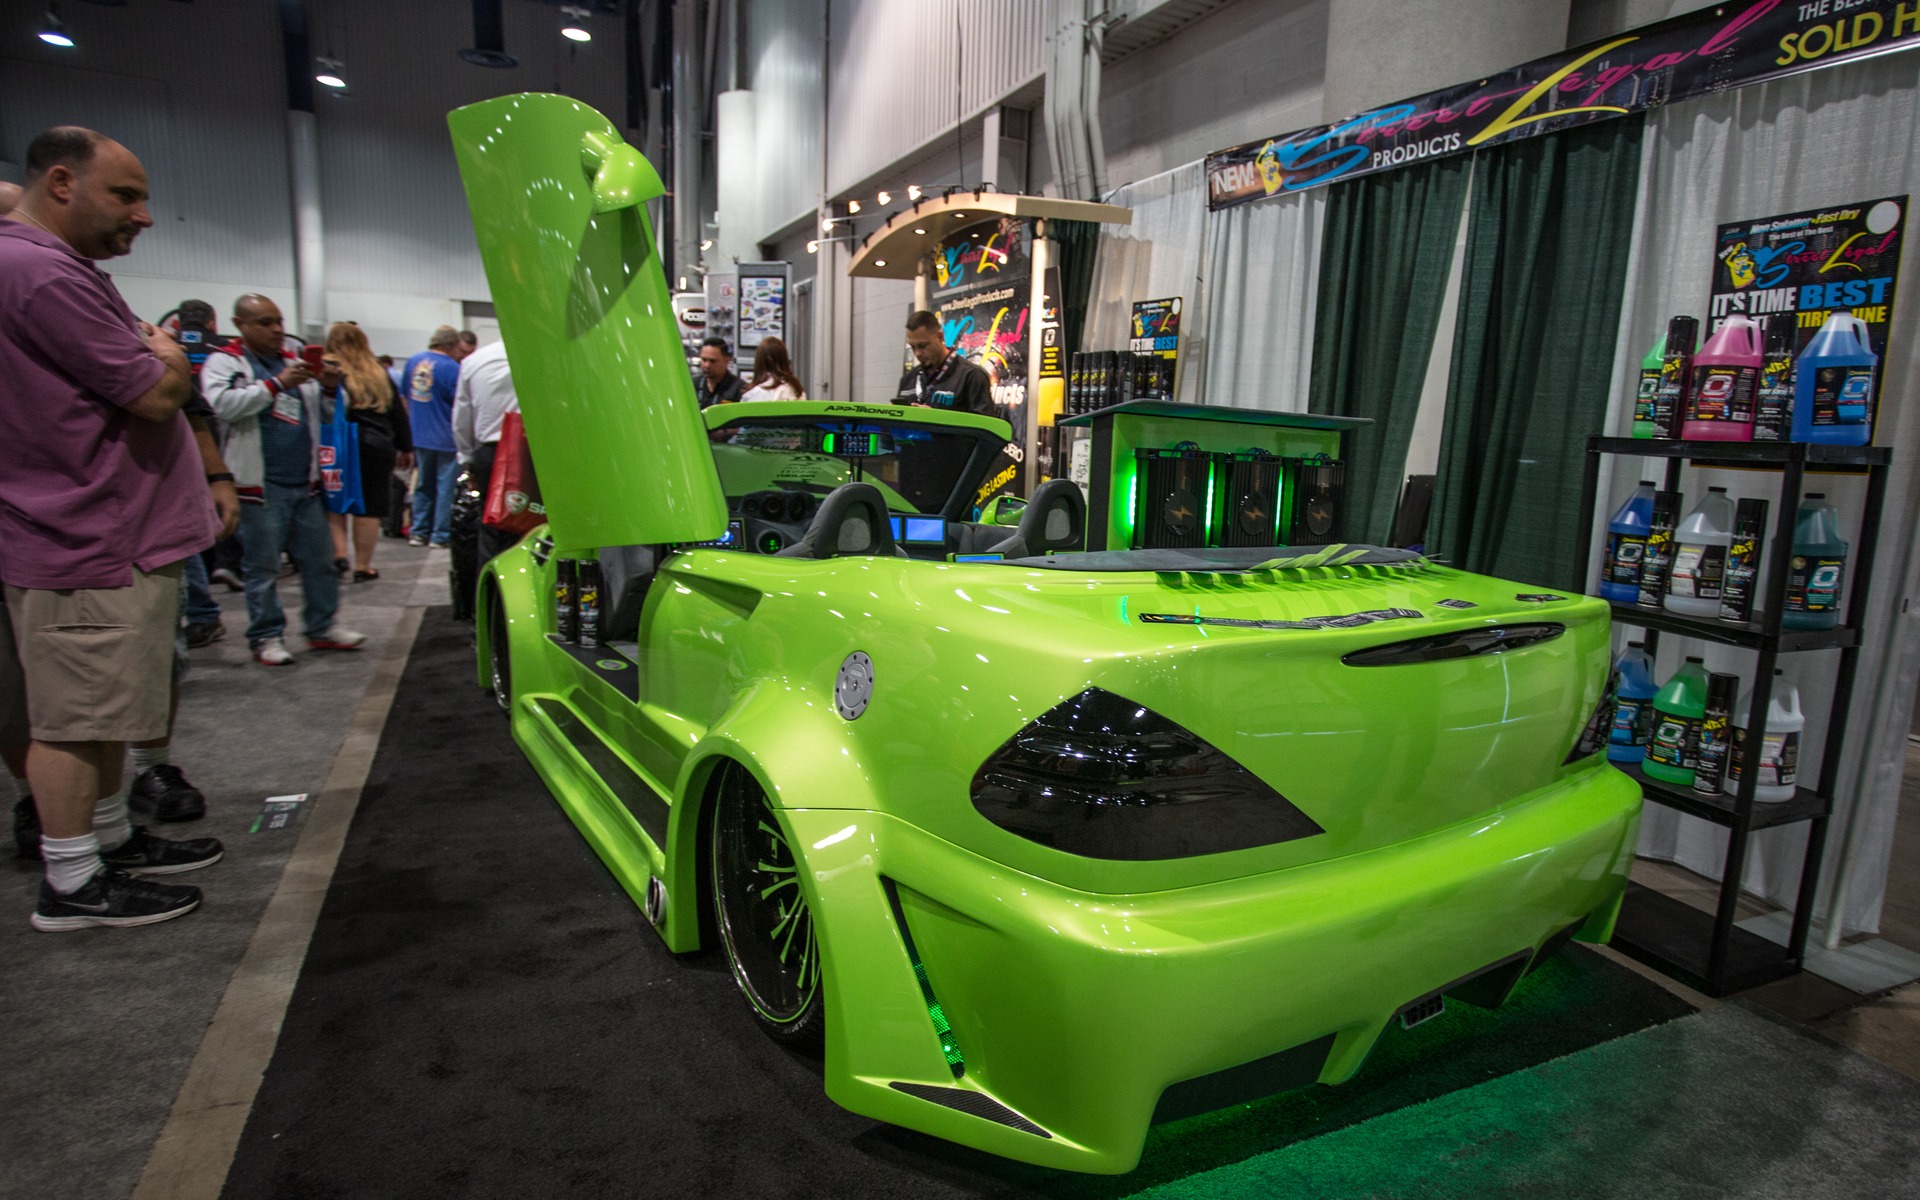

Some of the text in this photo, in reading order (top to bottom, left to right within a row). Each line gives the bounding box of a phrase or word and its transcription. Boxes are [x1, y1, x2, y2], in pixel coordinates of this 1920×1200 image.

[1798, 0, 1830, 22] THE
[1775, 12, 1884, 66] SOLD
[1373, 132, 1461, 168] PRODUCTS
[1214, 160, 1255, 195] NEW!
[1711, 276, 1893, 317] IT'S TIME BEST
[1852, 305, 1888, 324] INE
